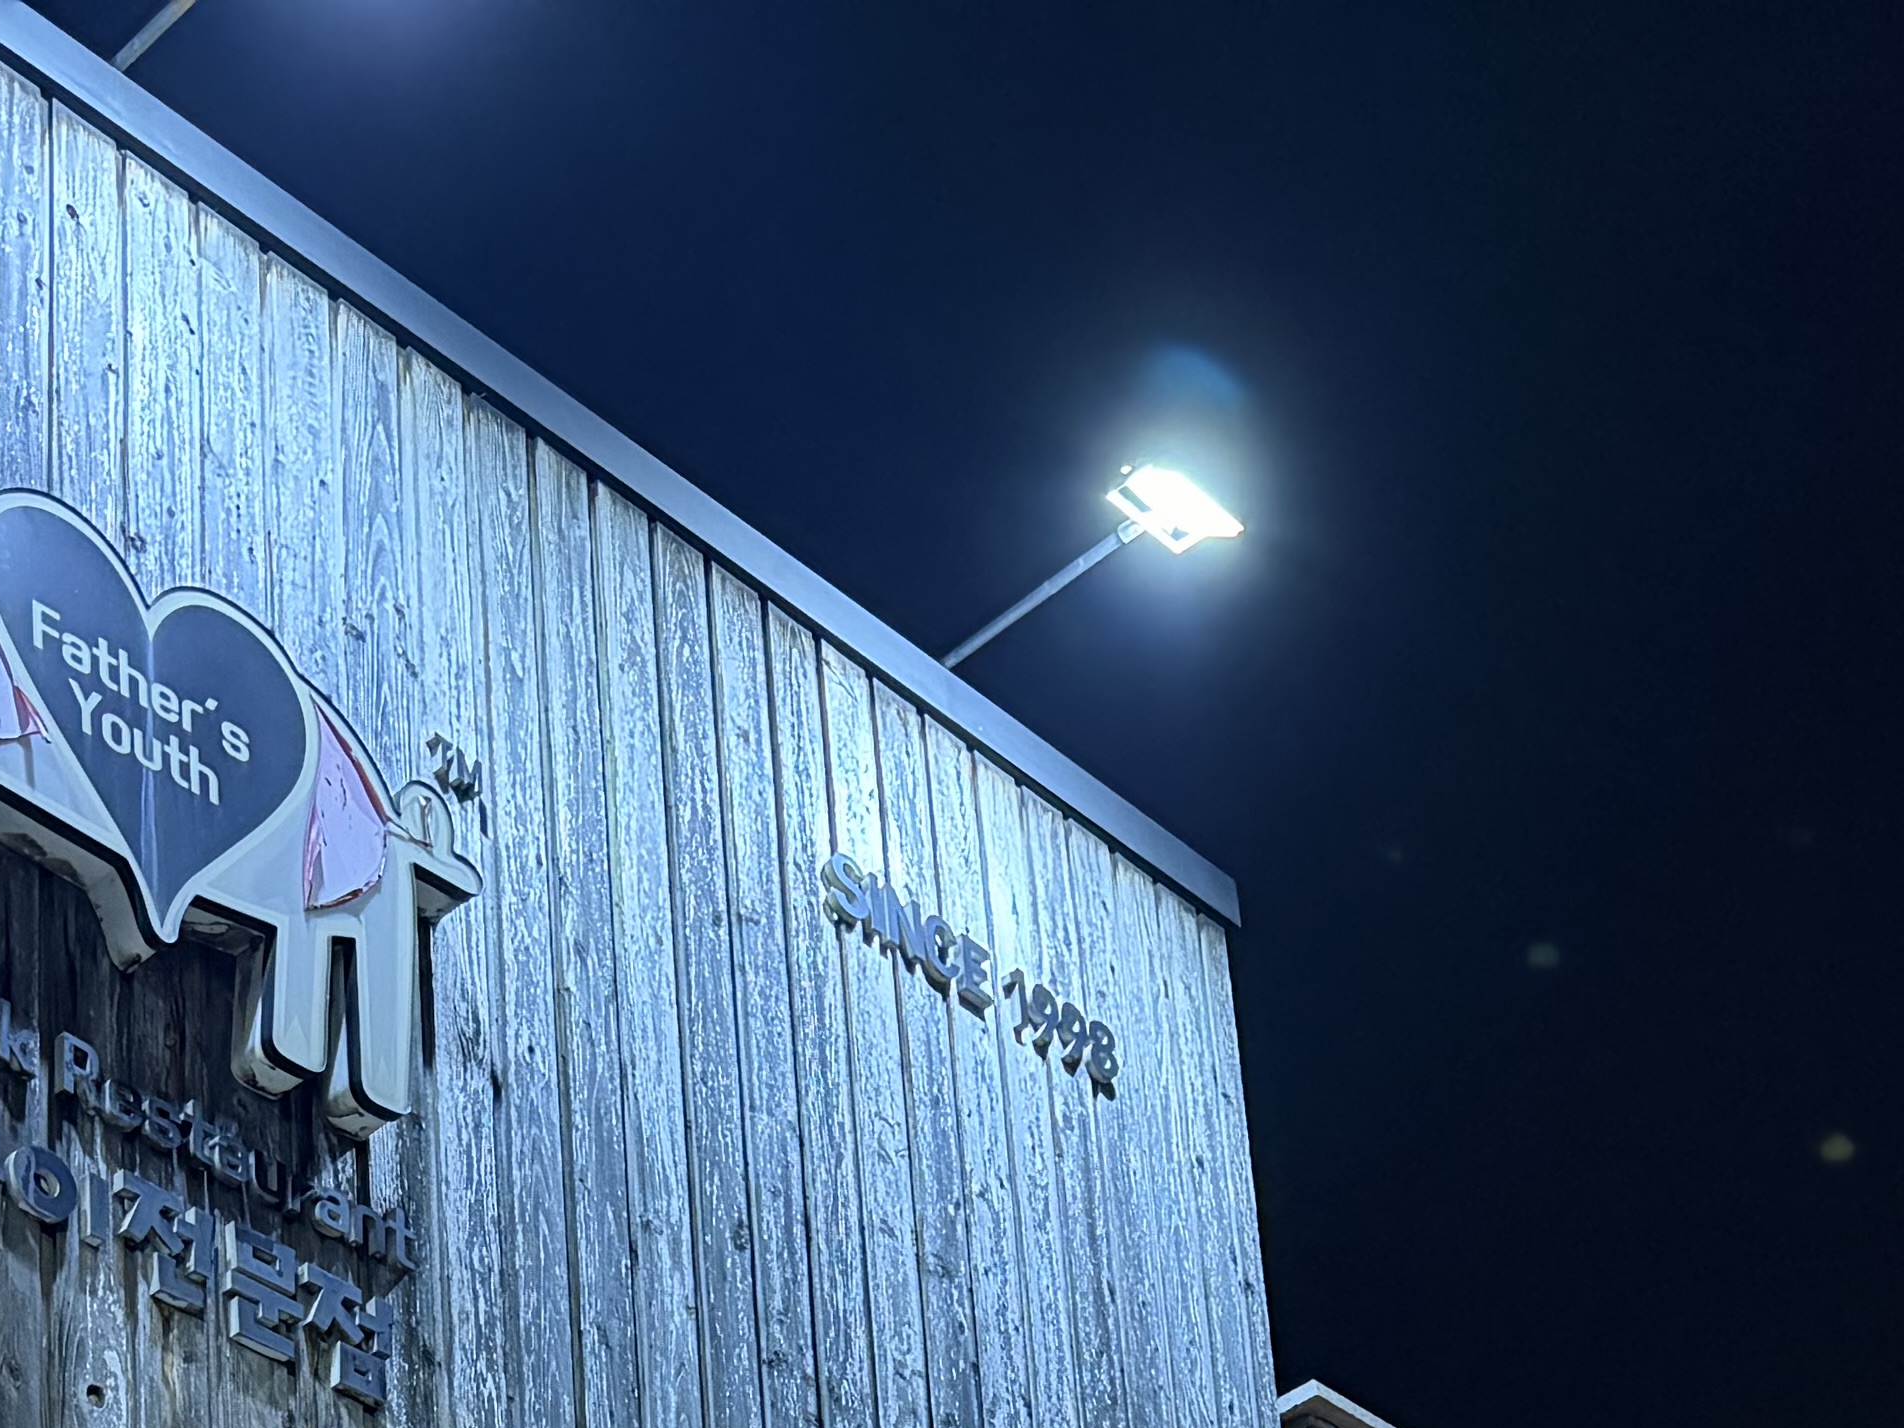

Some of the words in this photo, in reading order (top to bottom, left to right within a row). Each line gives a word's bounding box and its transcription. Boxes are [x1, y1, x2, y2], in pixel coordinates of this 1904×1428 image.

[32, 600, 251, 763] Father's
[65, 677, 221, 806] Youth
[820, 852, 994, 1008] SINCE
[53, 1031, 417, 1273] Restaurant
